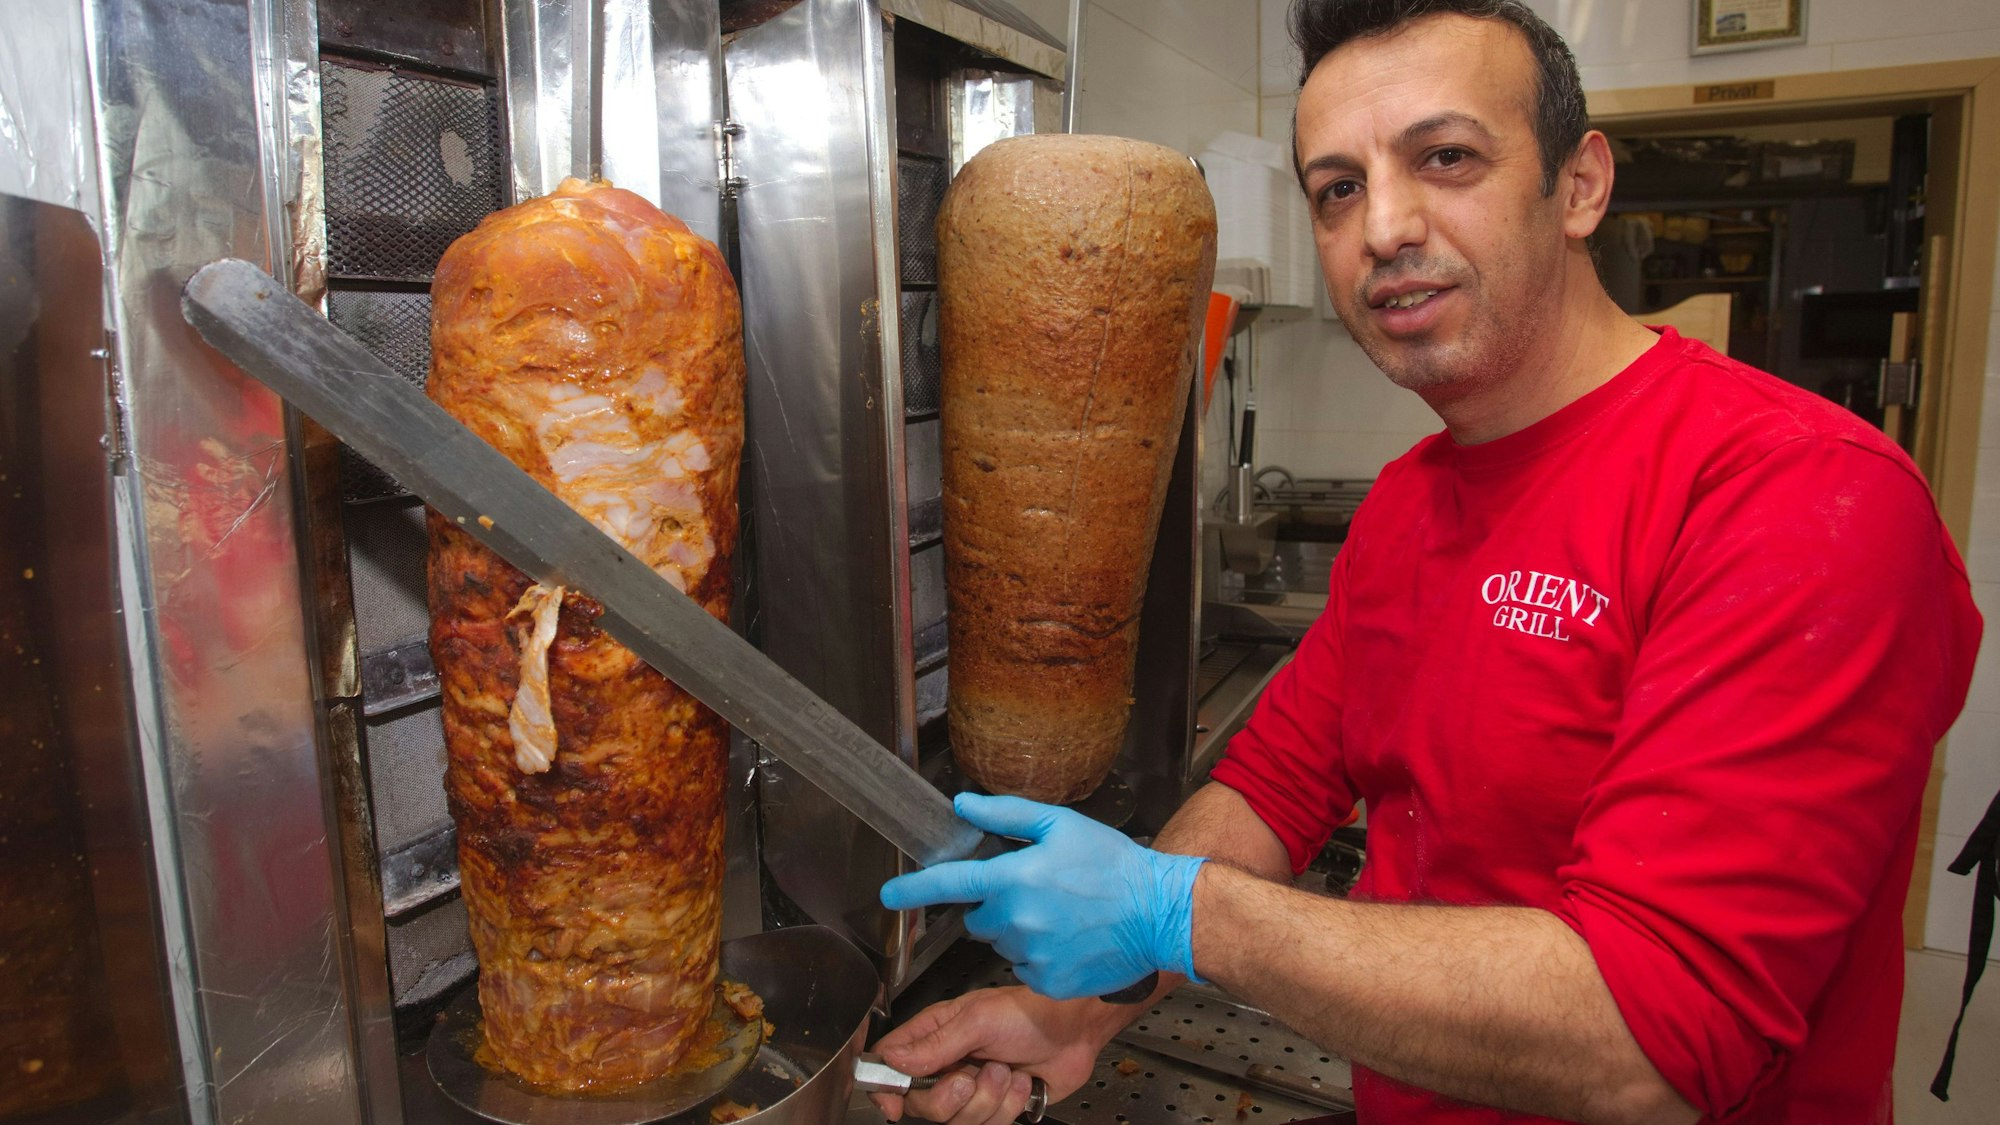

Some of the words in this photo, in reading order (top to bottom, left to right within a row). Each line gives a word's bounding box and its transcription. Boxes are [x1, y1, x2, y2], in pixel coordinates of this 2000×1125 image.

[1708, 84, 1758, 101] Privat
[1481, 570, 1610, 627] ORIENT
[1493, 605, 1569, 641] GRILL
